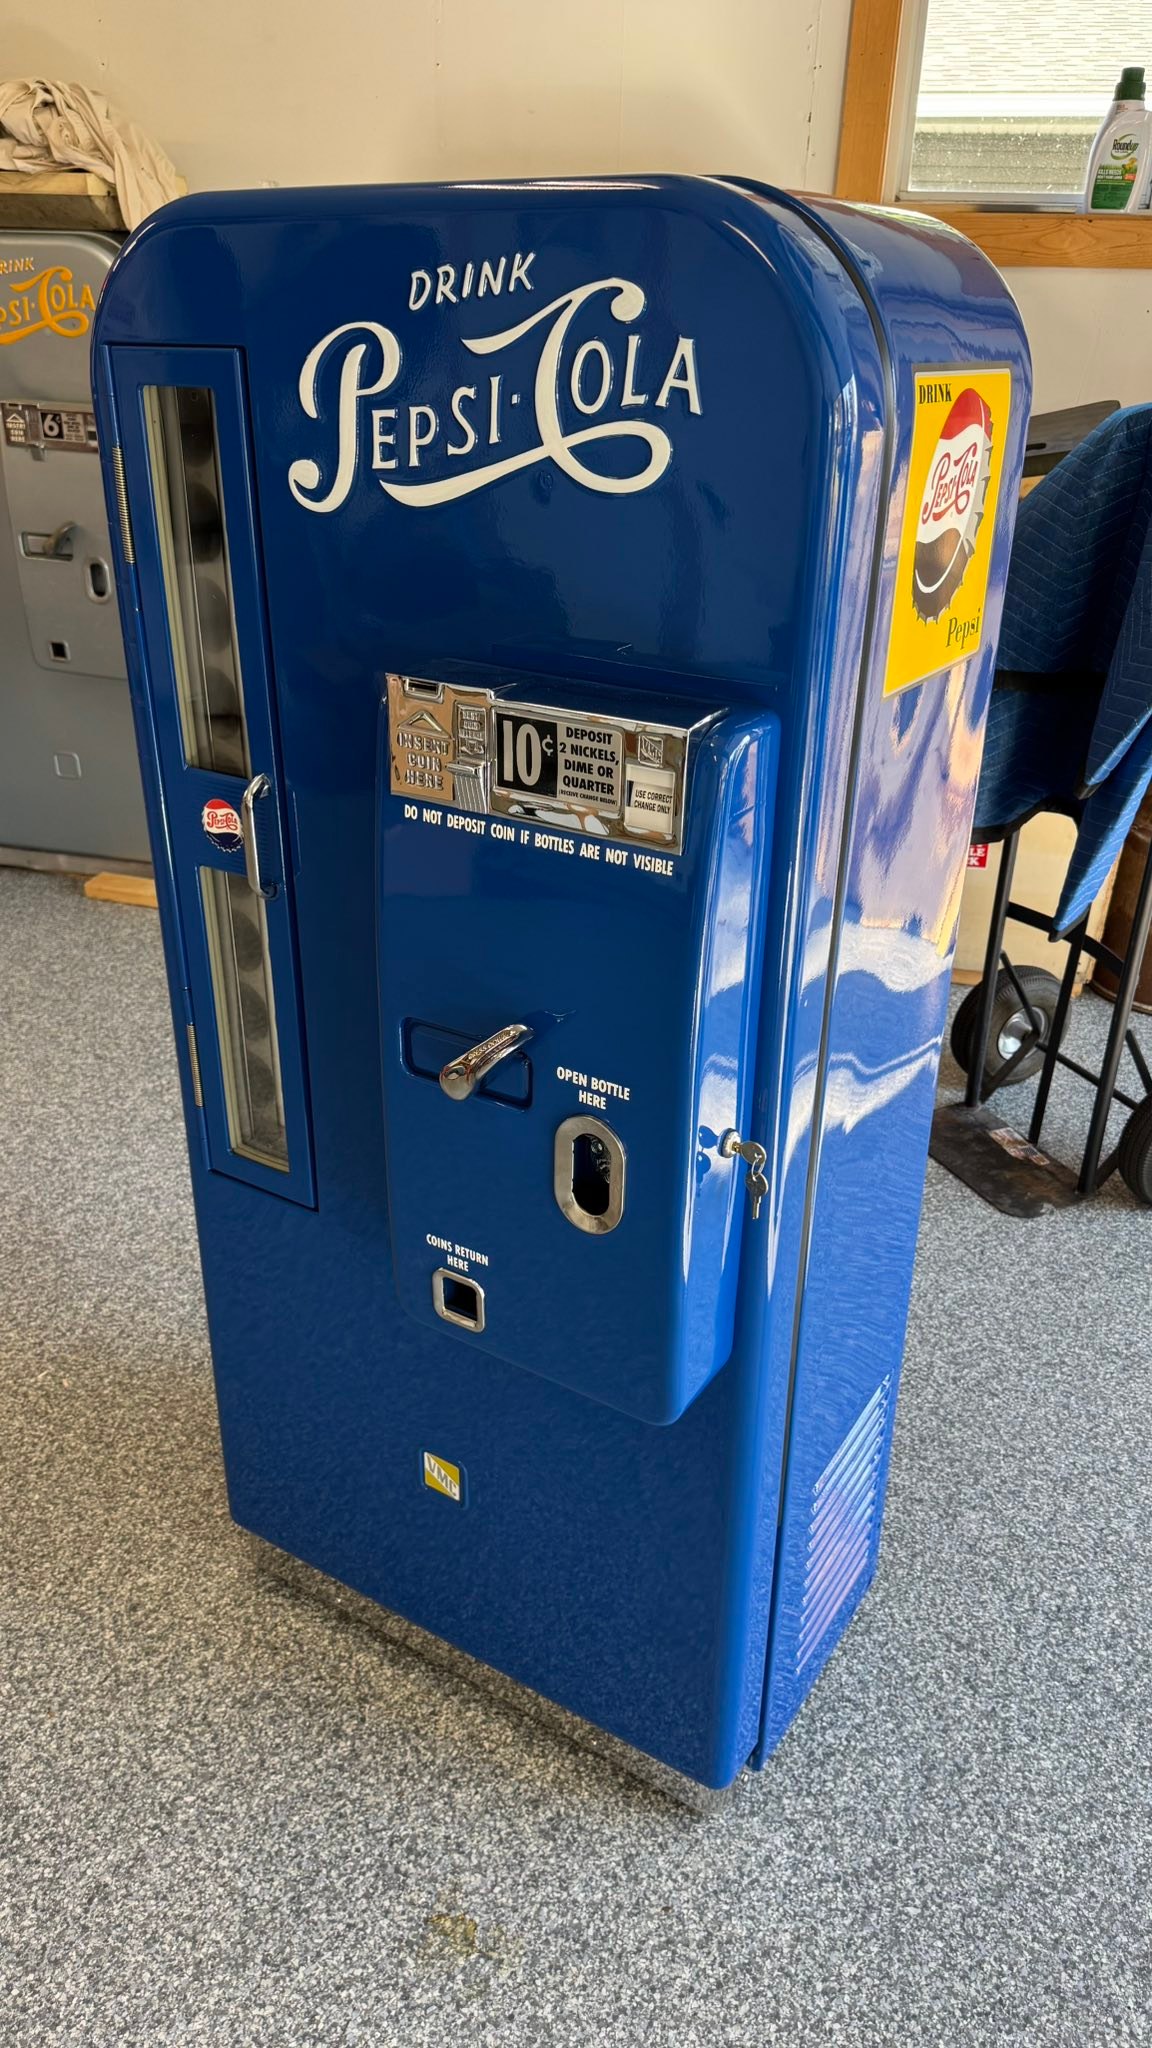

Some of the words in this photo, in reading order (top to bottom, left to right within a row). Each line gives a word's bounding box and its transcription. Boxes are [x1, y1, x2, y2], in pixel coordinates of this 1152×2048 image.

[1112, 138, 1140, 152] Roundup
[0, 256, 35, 275] RINK
[408, 251, 536, 311] DRINK
[918, 383, 952, 405] DRINK
[945, 607, 981, 650] Pepsi
[398, 732, 449, 756] INSERT
[566, 726, 613, 745] DEPOSIT
[407, 752, 442, 772] COIN
[559, 742, 566, 753] 2
[570, 744, 619, 766] NICKELS,
[405, 769, 443, 790] HERE
[564, 759, 594, 775] DIME
[597, 765, 614, 779] OR
[562, 775, 615, 795] QUARTER
[580, 793, 599, 802] CHANGE
[635, 789, 646, 799] USE
[647, 791, 673, 804] CORRECT
[634, 800, 656, 812] CHANGE
[657, 804, 671, 815] ONLY
[404, 804, 418, 820] DO
[422, 808, 443, 825] NOT
[446, 813, 487, 835] DEPOSIT
[490, 823, 515, 842] COIN
[520, 829, 530, 845] IF
[534, 833, 575, 855] BOTTLES
[579, 843, 600, 860] ARE
[605, 848, 628, 866] NOT
[633, 853, 674, 876] VISIBLE
[556, 1066, 588, 1088] OPEN
[590, 1076, 631, 1101] BOTTLE
[578, 1089, 607, 1110] HERE
[426, 1233, 453, 1253] COINS
[454, 1244, 489, 1267] RETURN
[447, 1254, 469, 1272] HERE
[425, 1454, 458, 1498] VMC
